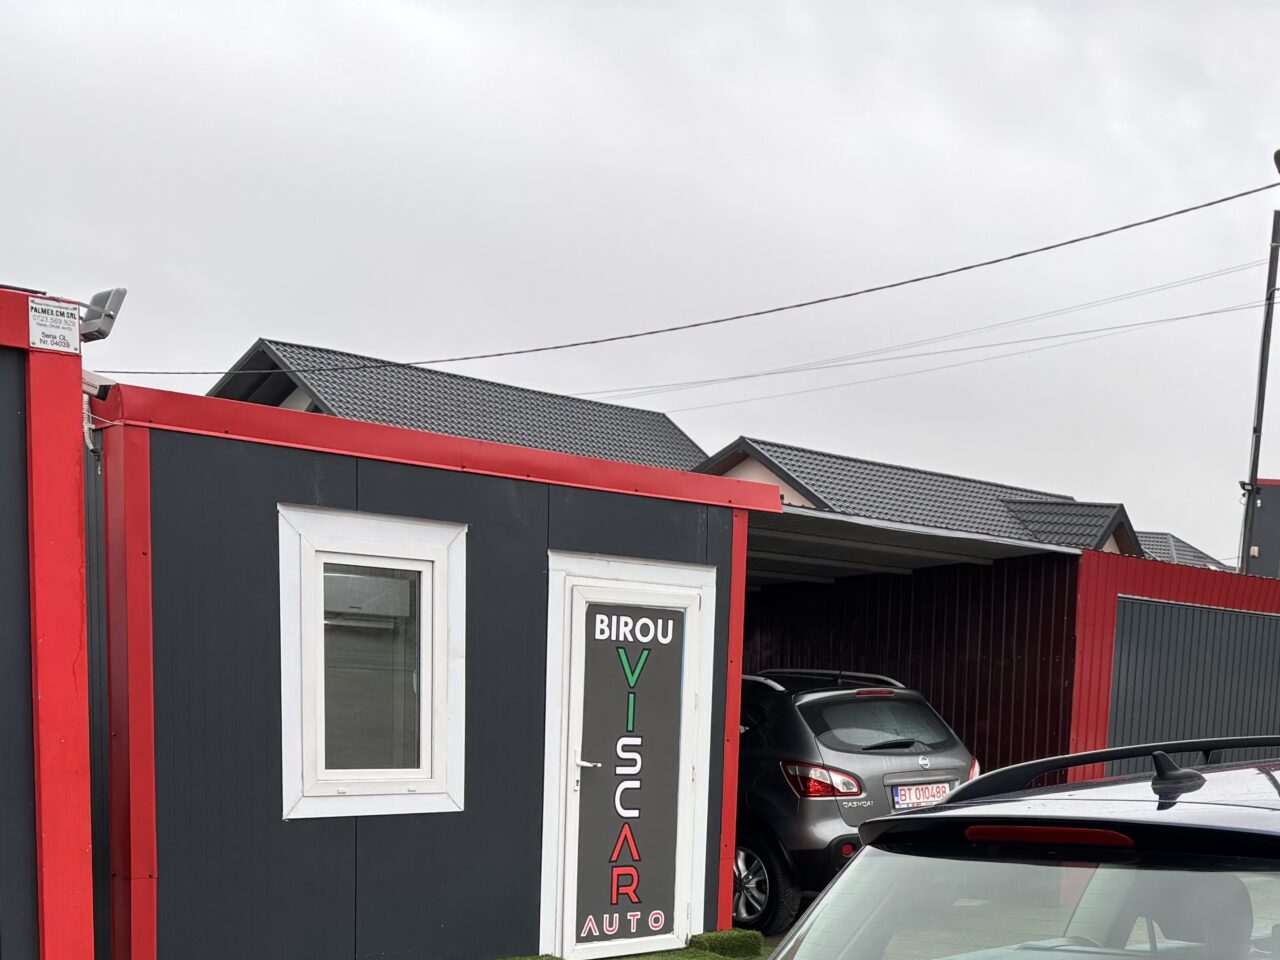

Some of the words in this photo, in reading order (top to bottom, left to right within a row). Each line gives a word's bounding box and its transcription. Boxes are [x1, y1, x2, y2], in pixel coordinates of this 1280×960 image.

[30, 306, 54, 316] PALMEX
[66, 312, 77, 320] SRL
[594, 613, 674, 645] BIROU
[608, 647, 651, 905] VISCAR
[900, 787, 912, 801] BT
[580, 910, 665, 937] AUTO
